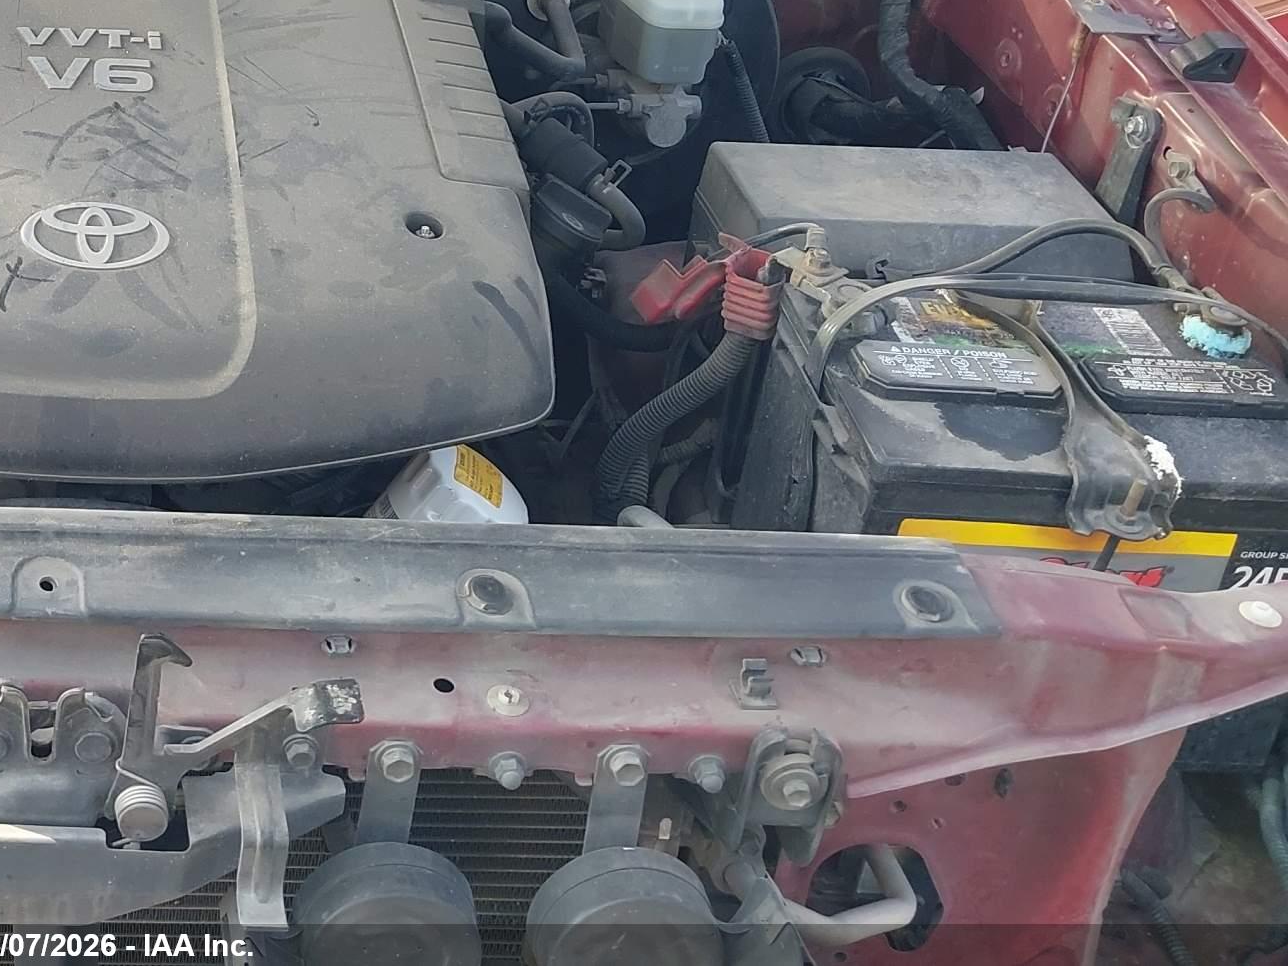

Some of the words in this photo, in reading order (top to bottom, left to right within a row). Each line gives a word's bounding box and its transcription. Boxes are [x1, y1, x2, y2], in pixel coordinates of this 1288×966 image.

[16, 27, 162, 50] VVT-i
[27, 56, 154, 92] V6
[902, 346, 952, 356] DANGER
[963, 349, 1008, 359] POISON
[1240, 551, 1278, 559] GROUP
